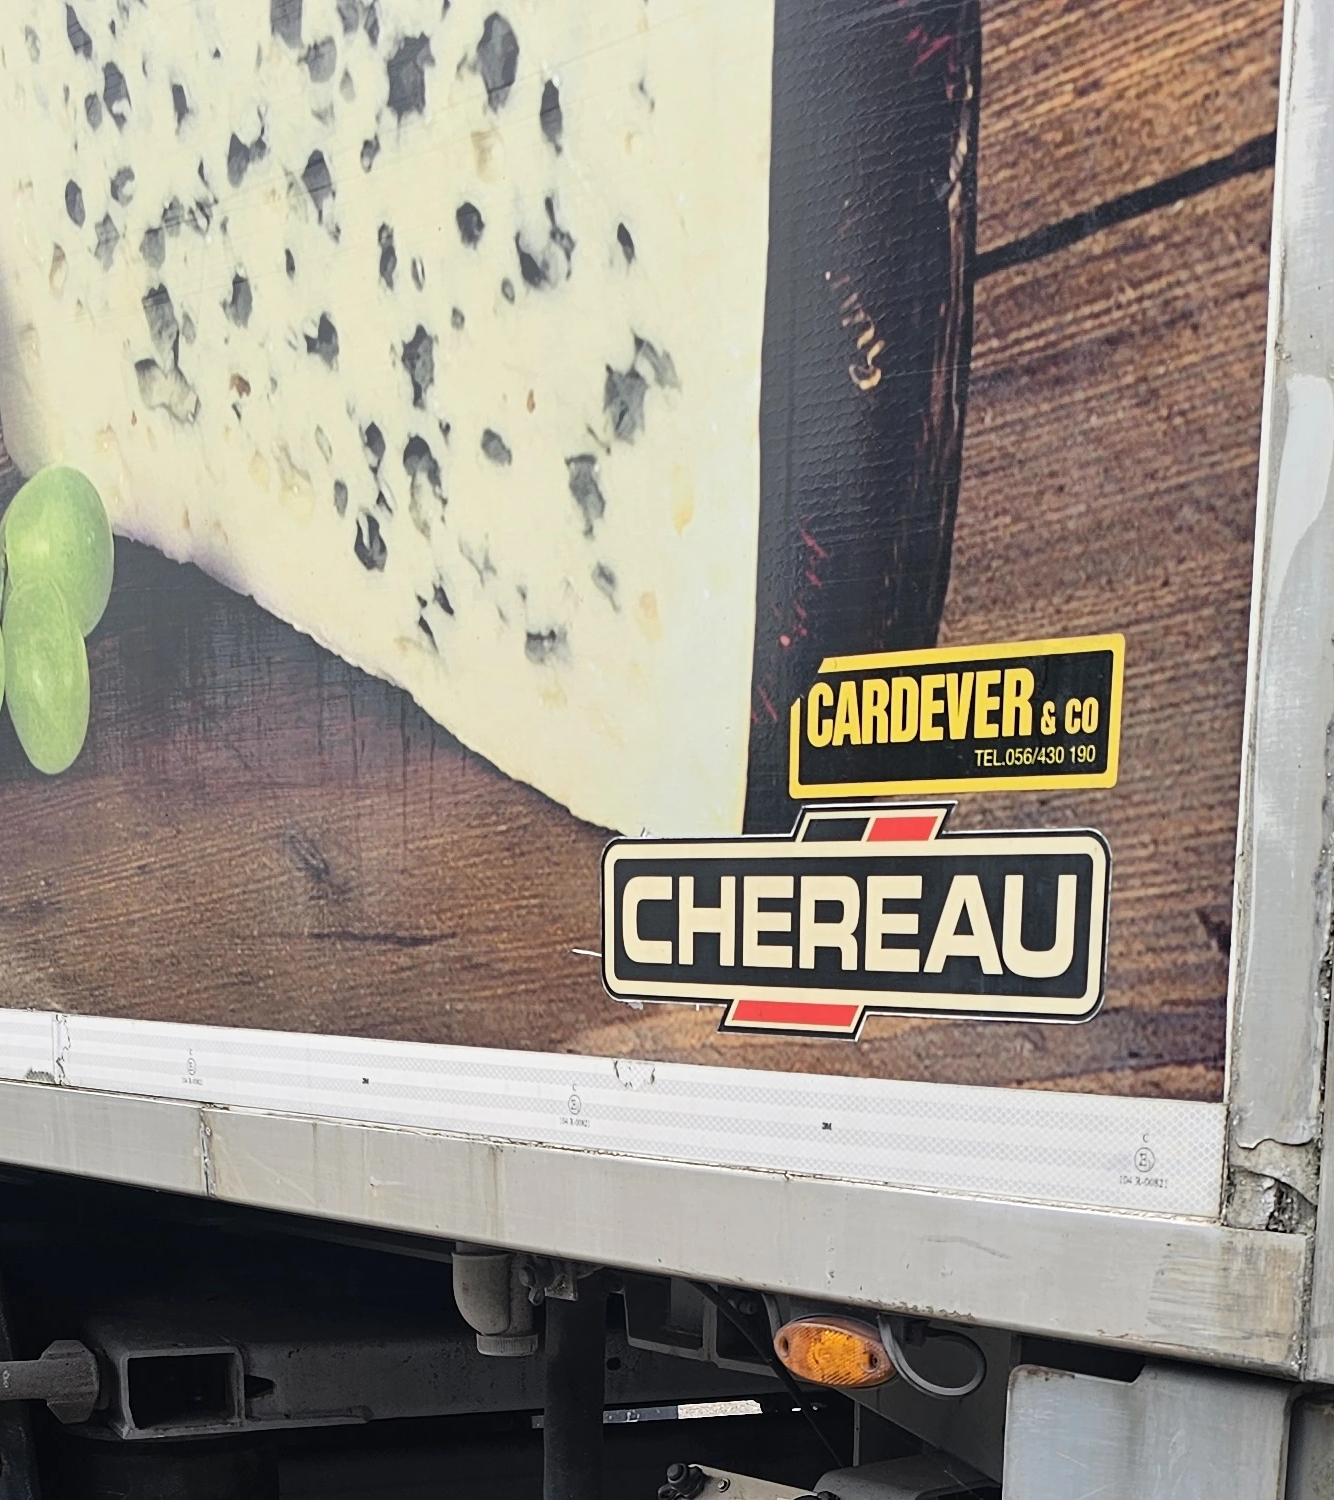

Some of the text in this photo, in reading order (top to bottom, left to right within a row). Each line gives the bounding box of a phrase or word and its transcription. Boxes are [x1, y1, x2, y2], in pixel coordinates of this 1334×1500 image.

[807, 667, 1099, 748] CARDEVER & CO
[1069, 744, 1096, 764] 190
[622, 873, 1078, 979] CHEREAU
